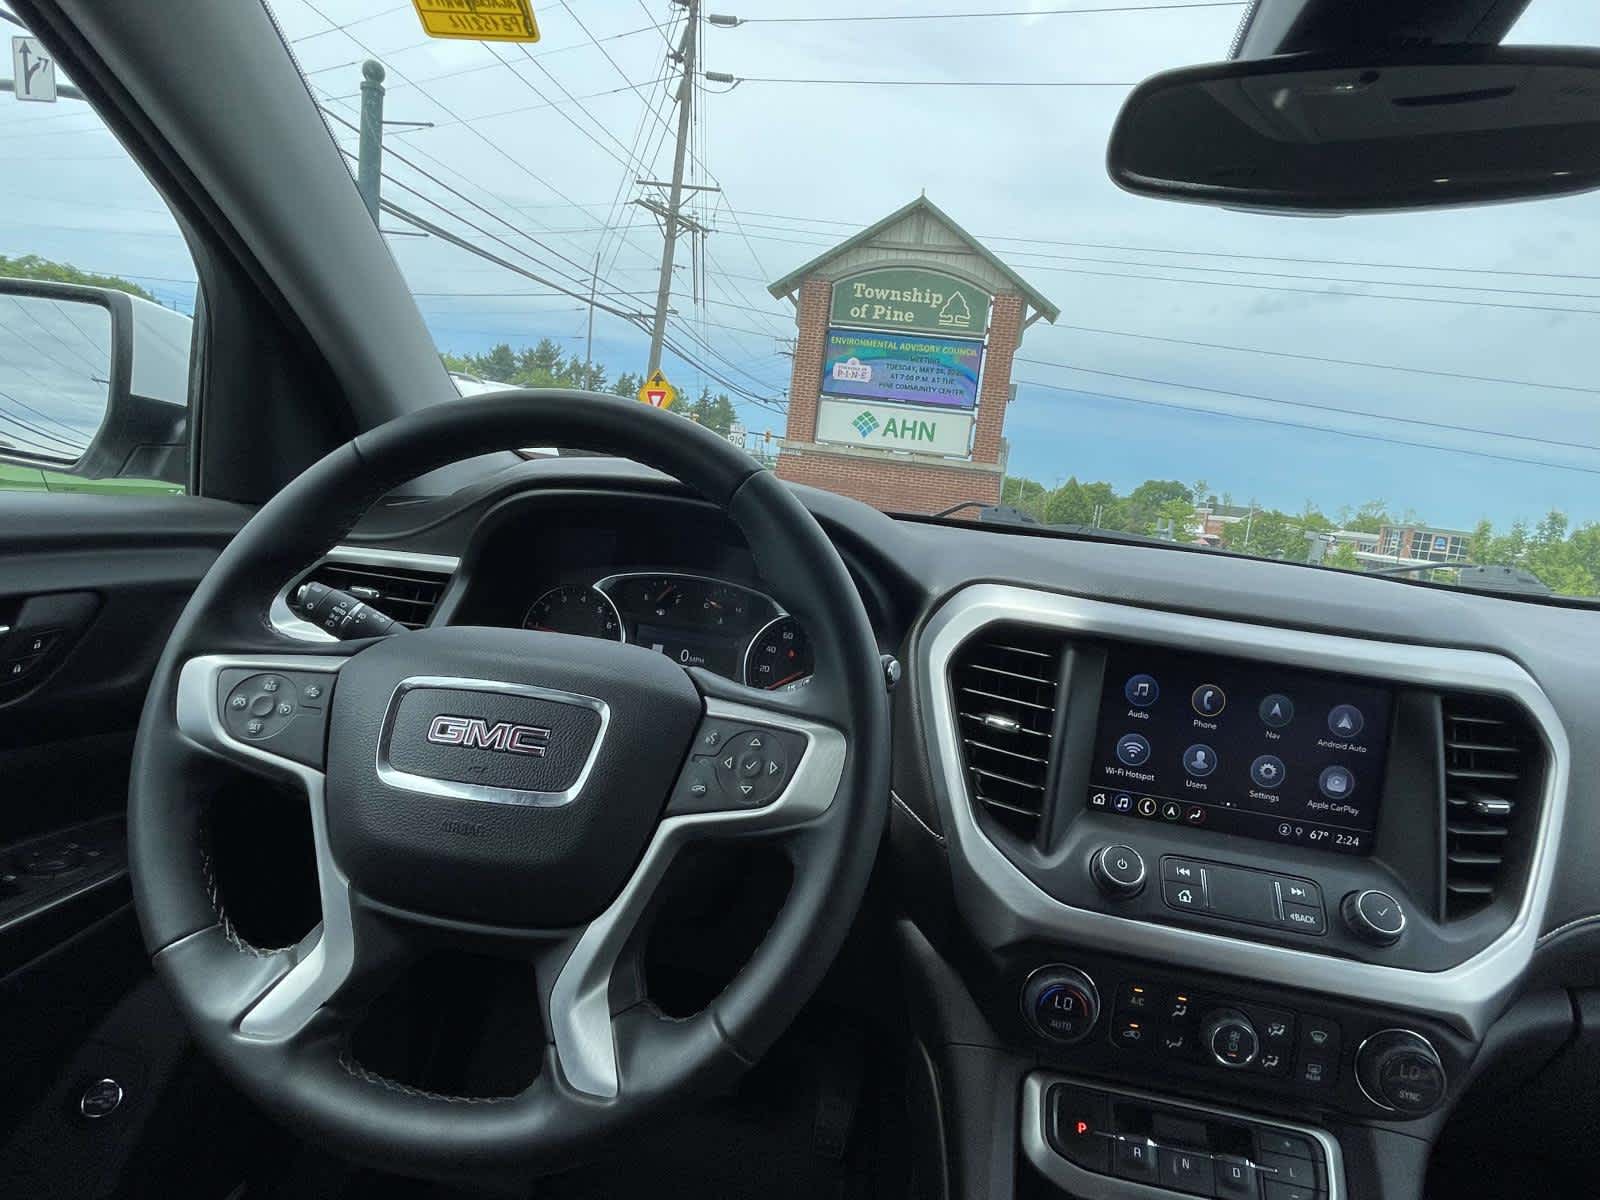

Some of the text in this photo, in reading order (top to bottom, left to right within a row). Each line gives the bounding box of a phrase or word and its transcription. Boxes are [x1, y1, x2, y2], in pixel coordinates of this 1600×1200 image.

[853, 282, 943, 308] Township
[850, 303, 915, 322] of Pine
[831, 336, 898, 350] ENVIRONMENTAL
[900, 343, 941, 353] ADVISORY
[882, 417, 936, 442] AHN
[782, 631, 794, 641] 60
[680, 649, 689, 662] 0
[765, 645, 777, 655] 40
[1128, 709, 1149, 719] Audio
[1193, 719, 1217, 730] Phone
[427, 715, 551, 757] GMC
[1265, 730, 1281, 740] Nav
[1317, 739, 1367, 753] Android Auto
[1105, 766, 1155, 782] Wi-Fi Hotspot
[1185, 779, 1208, 790] Users
[1249, 790, 1280, 803] Settings
[1306, 799, 1360, 816] Apple CarPlay
[1309, 830, 1329, 841] 67°
[1335, 834, 1360, 847] 2:24
[1295, 913, 1316, 924] BACK
[1077, 1121, 1088, 1134] P
[1133, 1146, 1142, 1158] R
[1182, 1158, 1190, 1169] N
[1232, 1167, 1241, 1178] D
